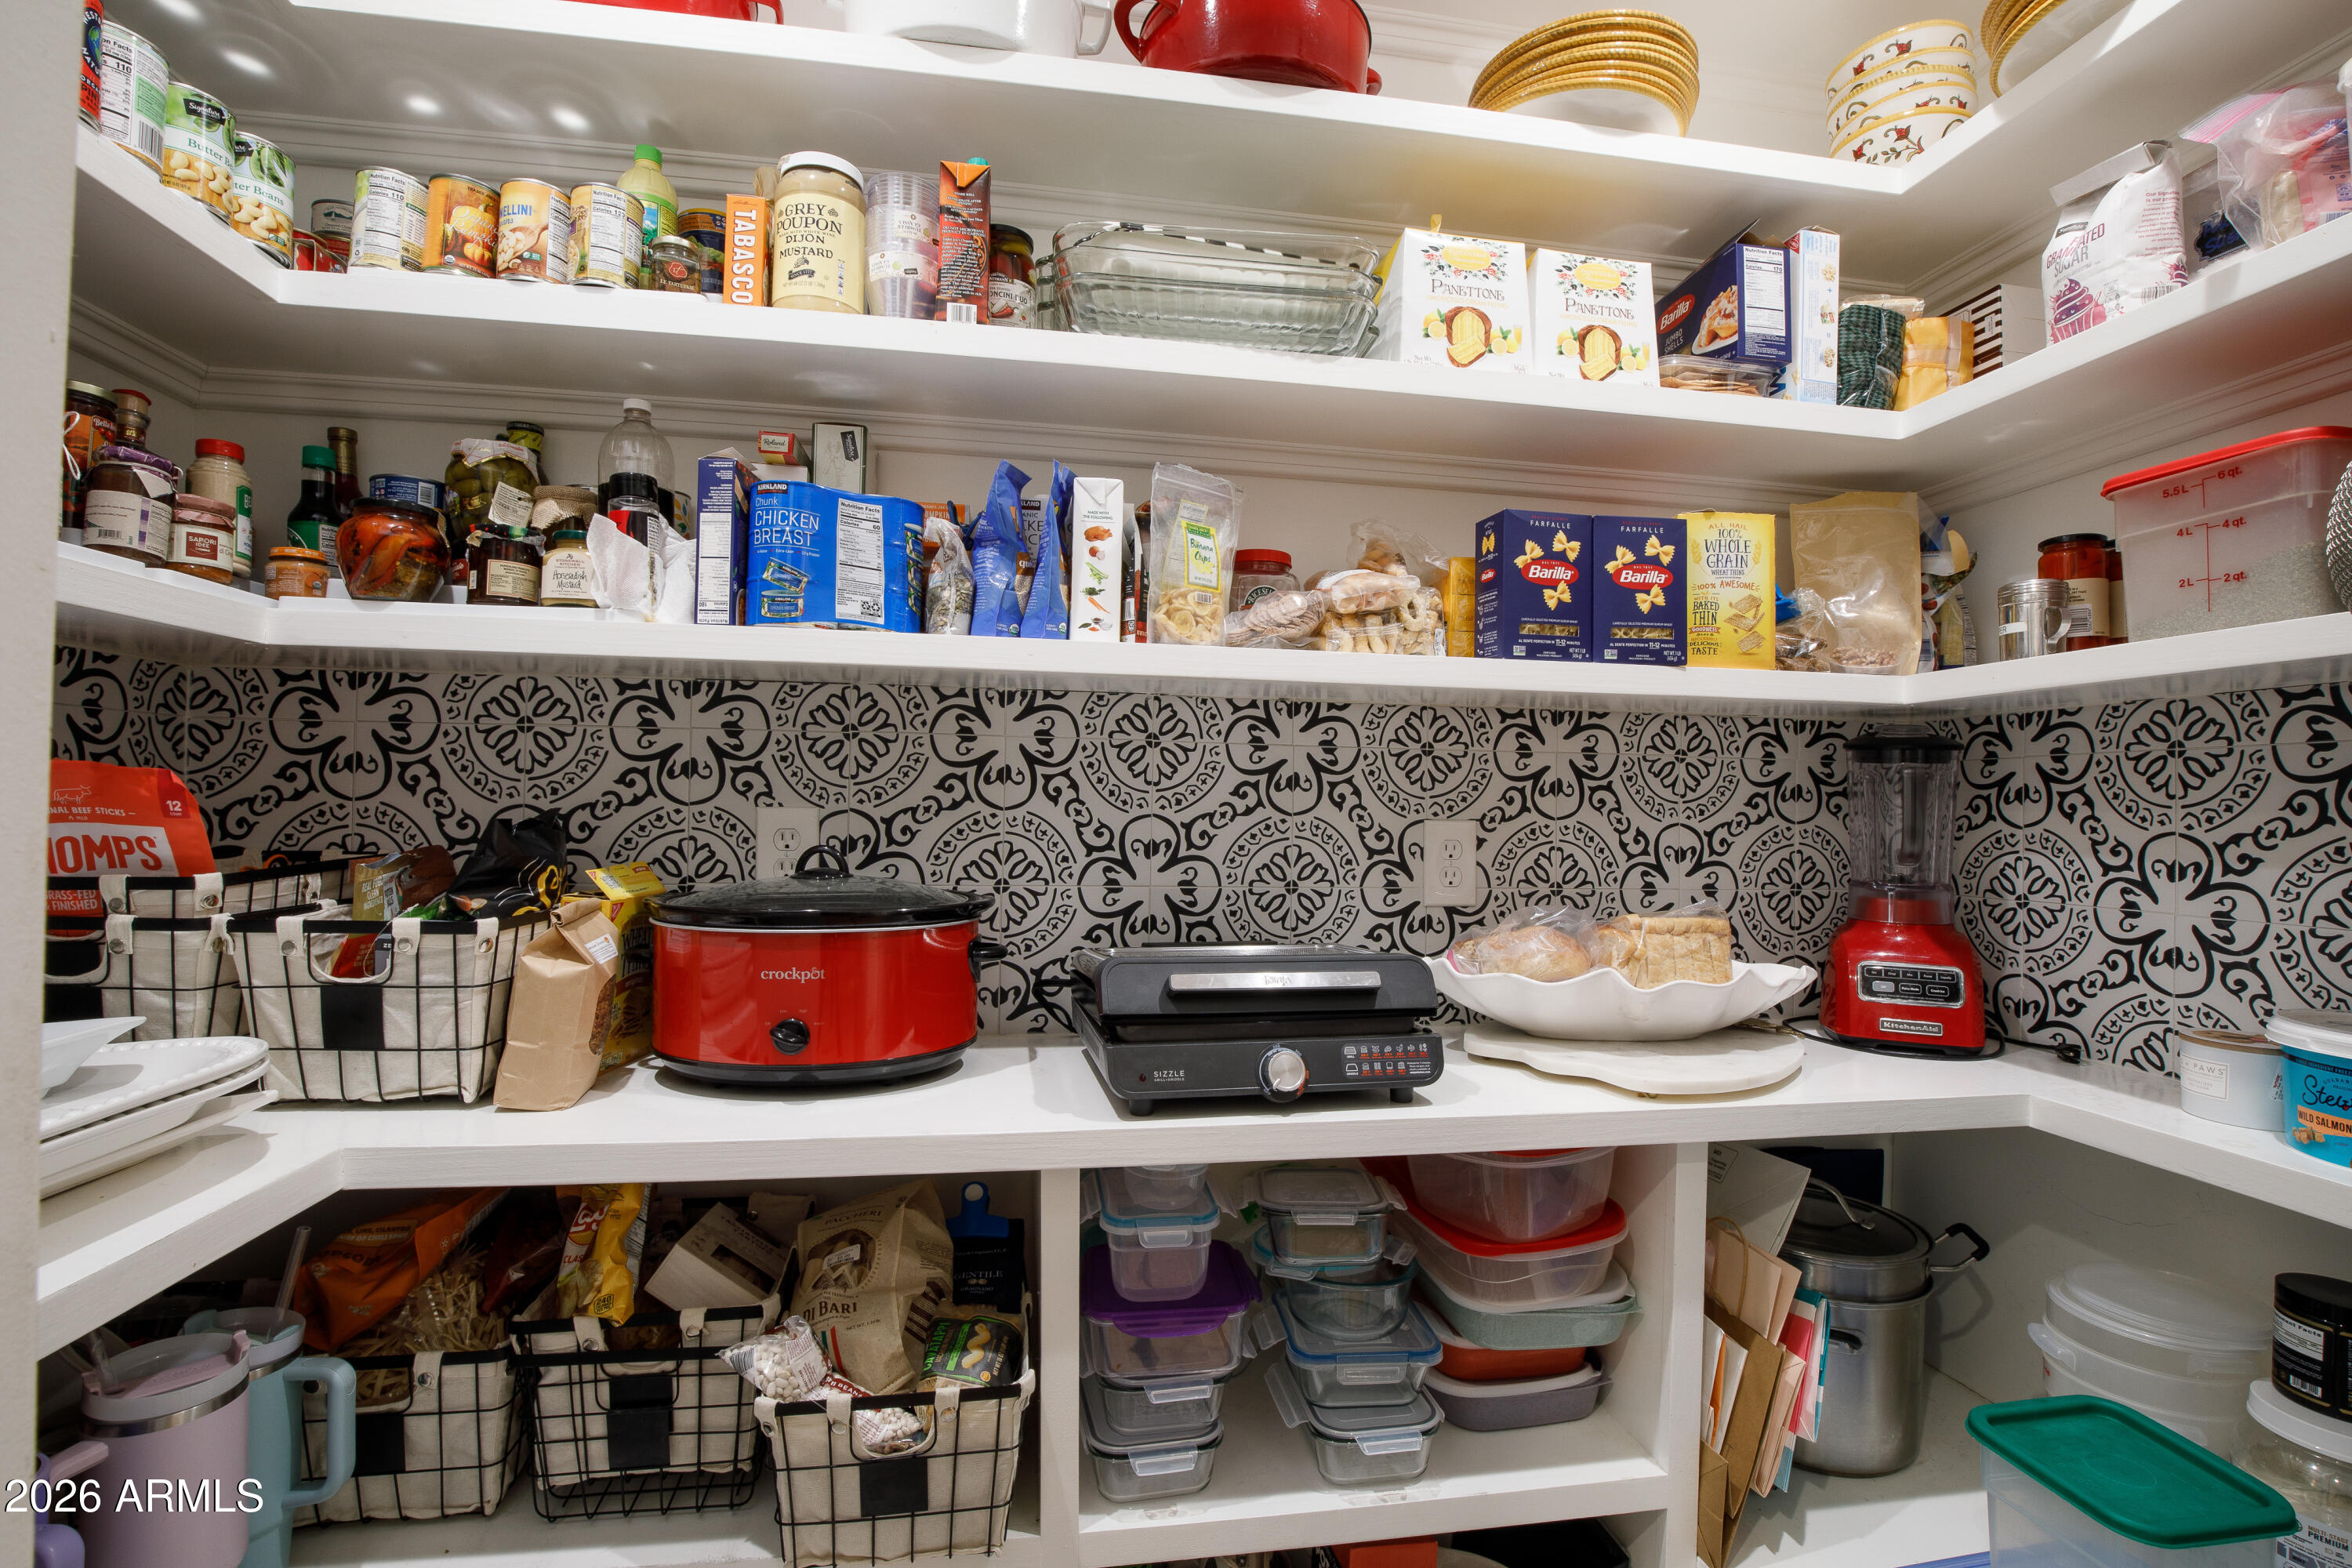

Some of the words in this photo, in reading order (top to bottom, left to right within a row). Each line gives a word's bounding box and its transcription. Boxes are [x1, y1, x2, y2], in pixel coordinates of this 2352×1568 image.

[115, 62, 132, 74] 110
[189, 102, 220, 118] Signature
[188, 138, 223, 161] Butter
[391, 176, 405, 186] Facts
[254, 186, 285, 205] Beans
[785, 202, 826, 216] GREY
[777, 216, 842, 234] POUPON
[786, 234, 825, 244] DIJON
[730, 209, 757, 305] TABASCO
[779, 247, 833, 259] MUSTARD
[1431, 280, 1504, 301] PANETTONE
[1564, 297, 1635, 320] PANETTONE
[1661, 300, 1690, 330] Barilla
[1665, 328, 1682, 347] JUMBO
[1664, 337, 1683, 355] SHELLS
[2217, 471, 2226, 480] 6
[2227, 466, 2242, 477] qt.
[756, 496, 779, 506] Chunk
[841, 502, 864, 510] Nutrition
[755, 510, 819, 531] CHICKEN
[1530, 520, 1571, 529] FARFALLE
[2222, 519, 2230, 528] 4
[2231, 516, 2247, 528] qt.
[188, 535, 216, 545] SAPORI
[754, 529, 813, 546] BREAST
[1718, 528, 1743, 539] 100%
[1190, 539, 1214, 552] Banana
[1704, 539, 1751, 554] WHOLE
[1195, 550, 1210, 563] Chips
[1707, 554, 1748, 568] GRAIN
[1529, 565, 1572, 580] Barilla
[1620, 570, 1666, 584] Barilla
[2223, 574, 2230, 583] 2
[2231, 571, 2248, 582] qt.
[557, 581, 582, 590] Mustard
[1697, 583, 1716, 591] 100%
[1720, 580, 1756, 591] AWESOME
[1693, 601, 1719, 612] BAKED
[1693, 612, 1718, 626] THIN
[96, 807, 126, 817] STICKS
[165, 800, 183, 812] 12
[361, 881, 372, 893] REAL
[367, 888, 379, 899] CLEAN
[53, 899, 98, 911] FINISHED
[364, 896, 383, 910] INGREDIENTS
[760, 967, 826, 983] crockpot
[1883, 1022, 1938, 1033] KitchenAid
[2194, 1063, 2224, 1076] PAWS
[2298, 1109, 2314, 1123] WILD
[2315, 1115, 2352, 1134] SALMON
[954, 1270, 1004, 1279] GENTILE
[596, 1296, 612, 1305] 240
[818, 1301, 857, 1315] BARI
[2298, 1325, 2321, 1338] Facts
[2308, 1530, 2349, 1552] PREMIUM
